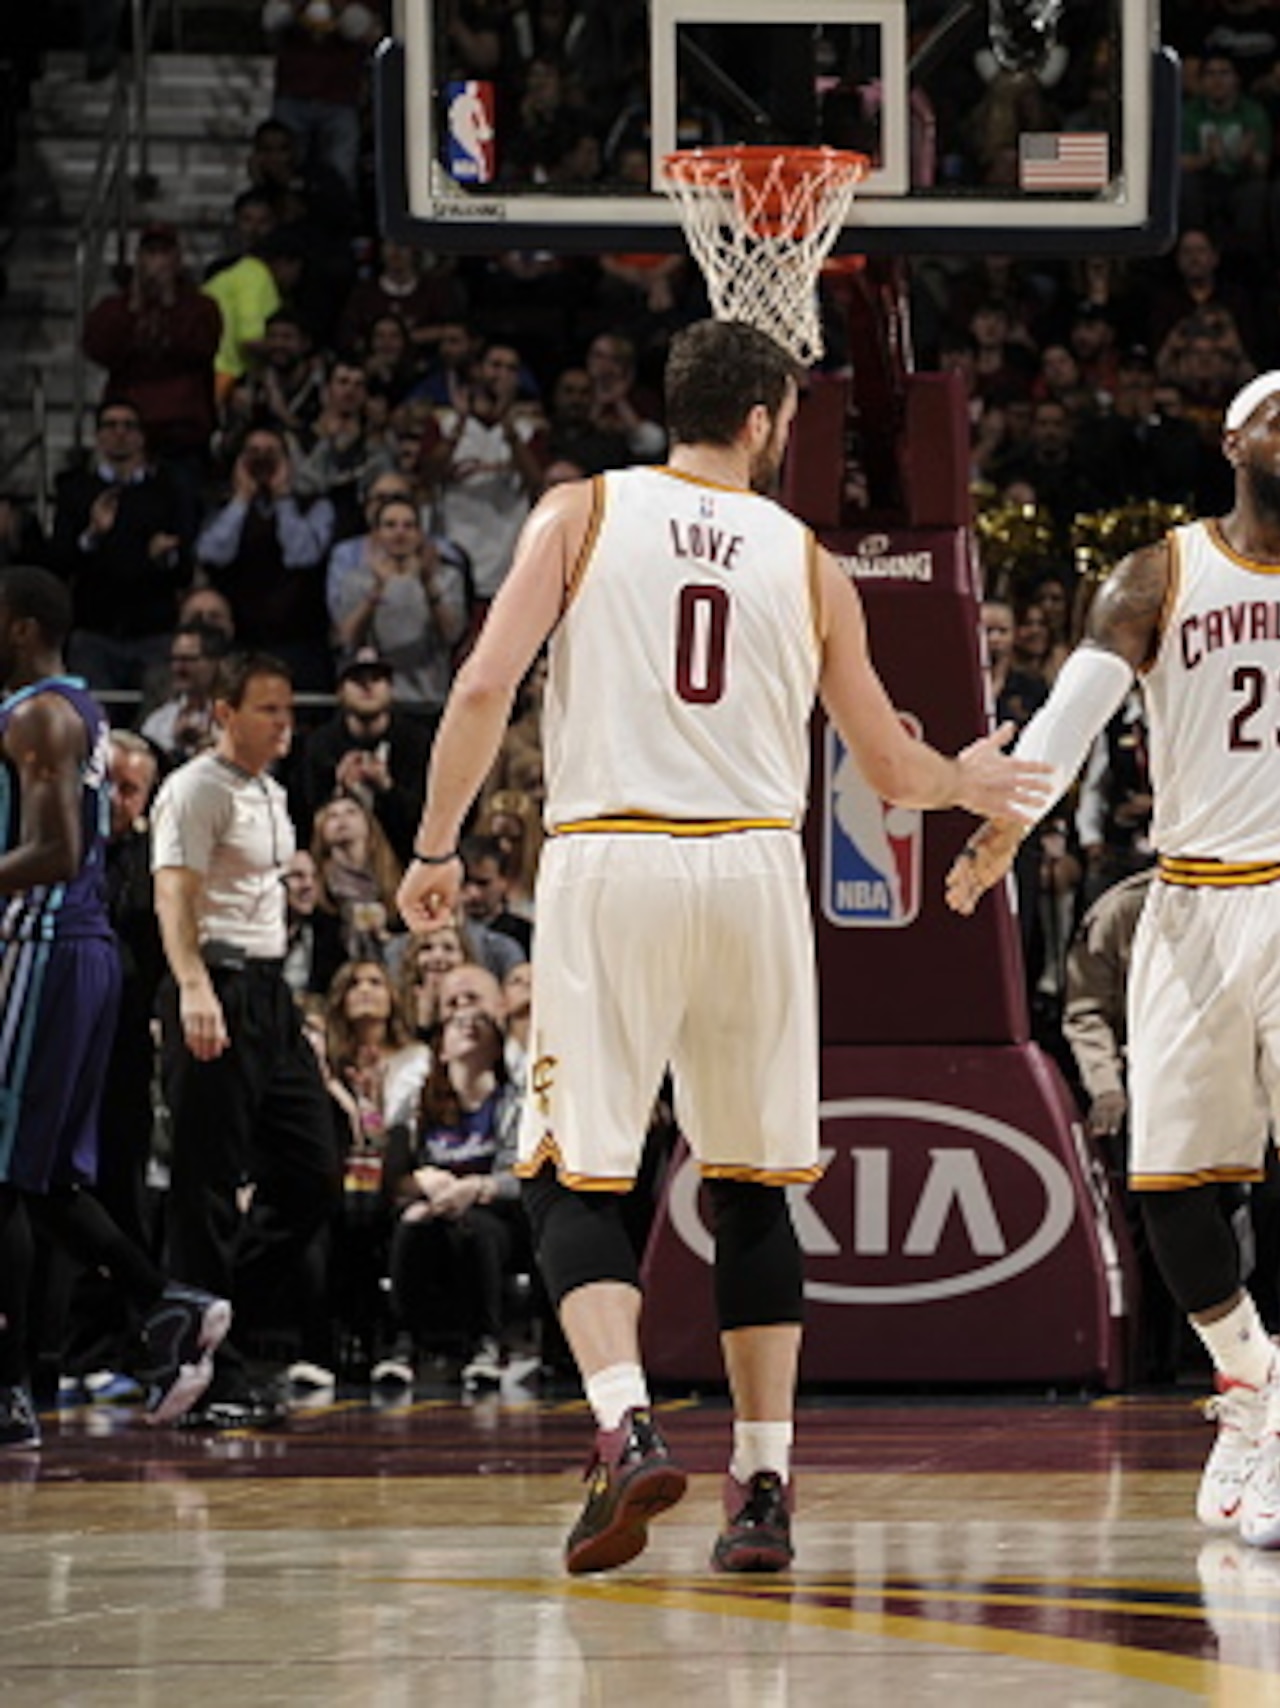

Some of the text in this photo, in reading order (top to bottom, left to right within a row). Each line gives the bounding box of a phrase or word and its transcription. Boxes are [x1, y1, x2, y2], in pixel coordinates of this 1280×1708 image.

[670, 518, 743, 570] LOVE
[675, 584, 730, 704] 0
[837, 881, 888, 910] NBA
